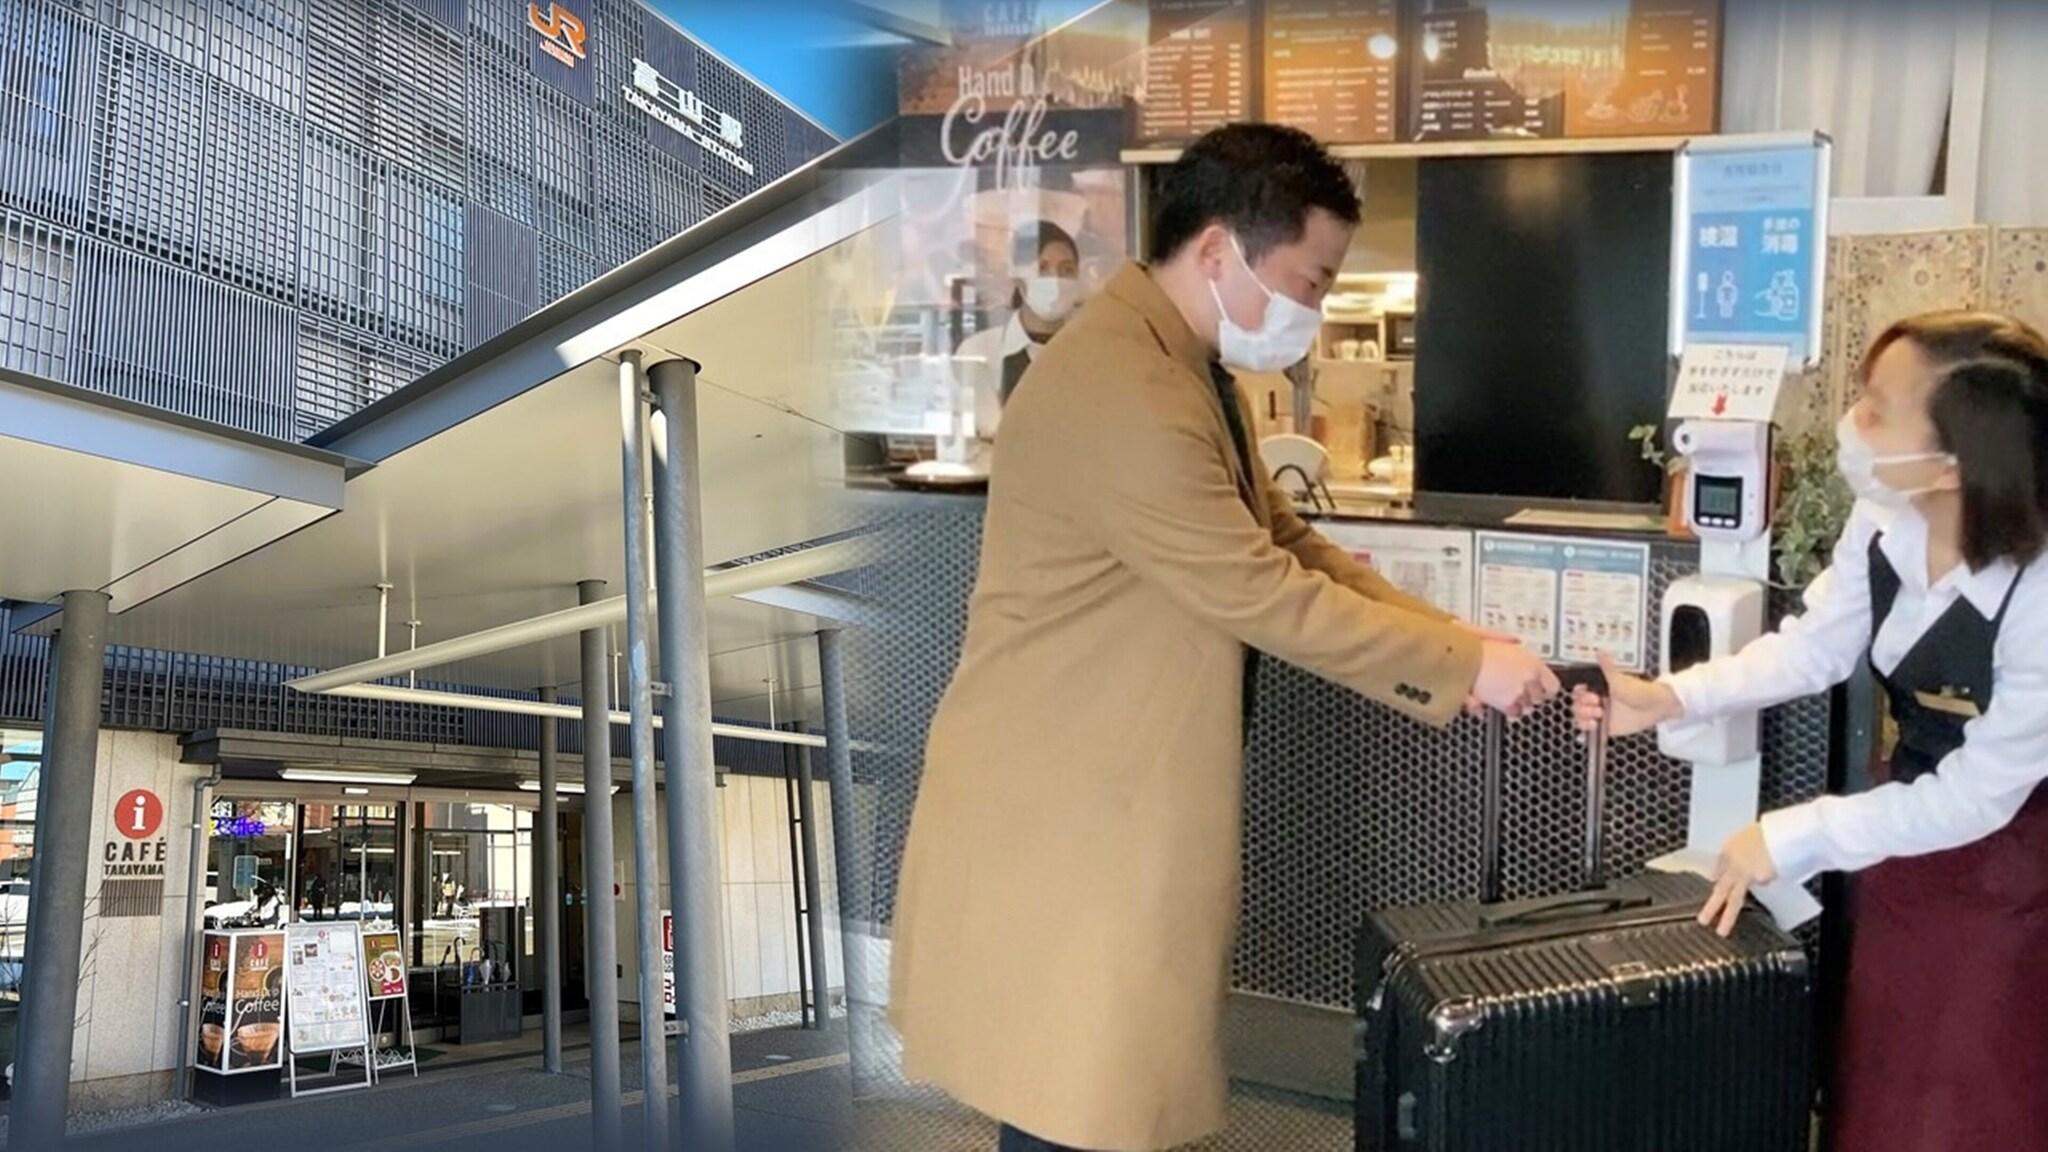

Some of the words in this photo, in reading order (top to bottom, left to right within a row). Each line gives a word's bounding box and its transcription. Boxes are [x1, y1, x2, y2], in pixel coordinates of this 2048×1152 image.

[528, 1, 586, 59] JR
[958, 65, 1014, 98] Hand
[632, 57, 743, 149] 高山駅
[941, 95, 1079, 196] Coffee
[1699, 225, 1738, 248] 検温
[105, 837, 166, 862] CAFÉ
[104, 864, 164, 876] TAKAYAMA
